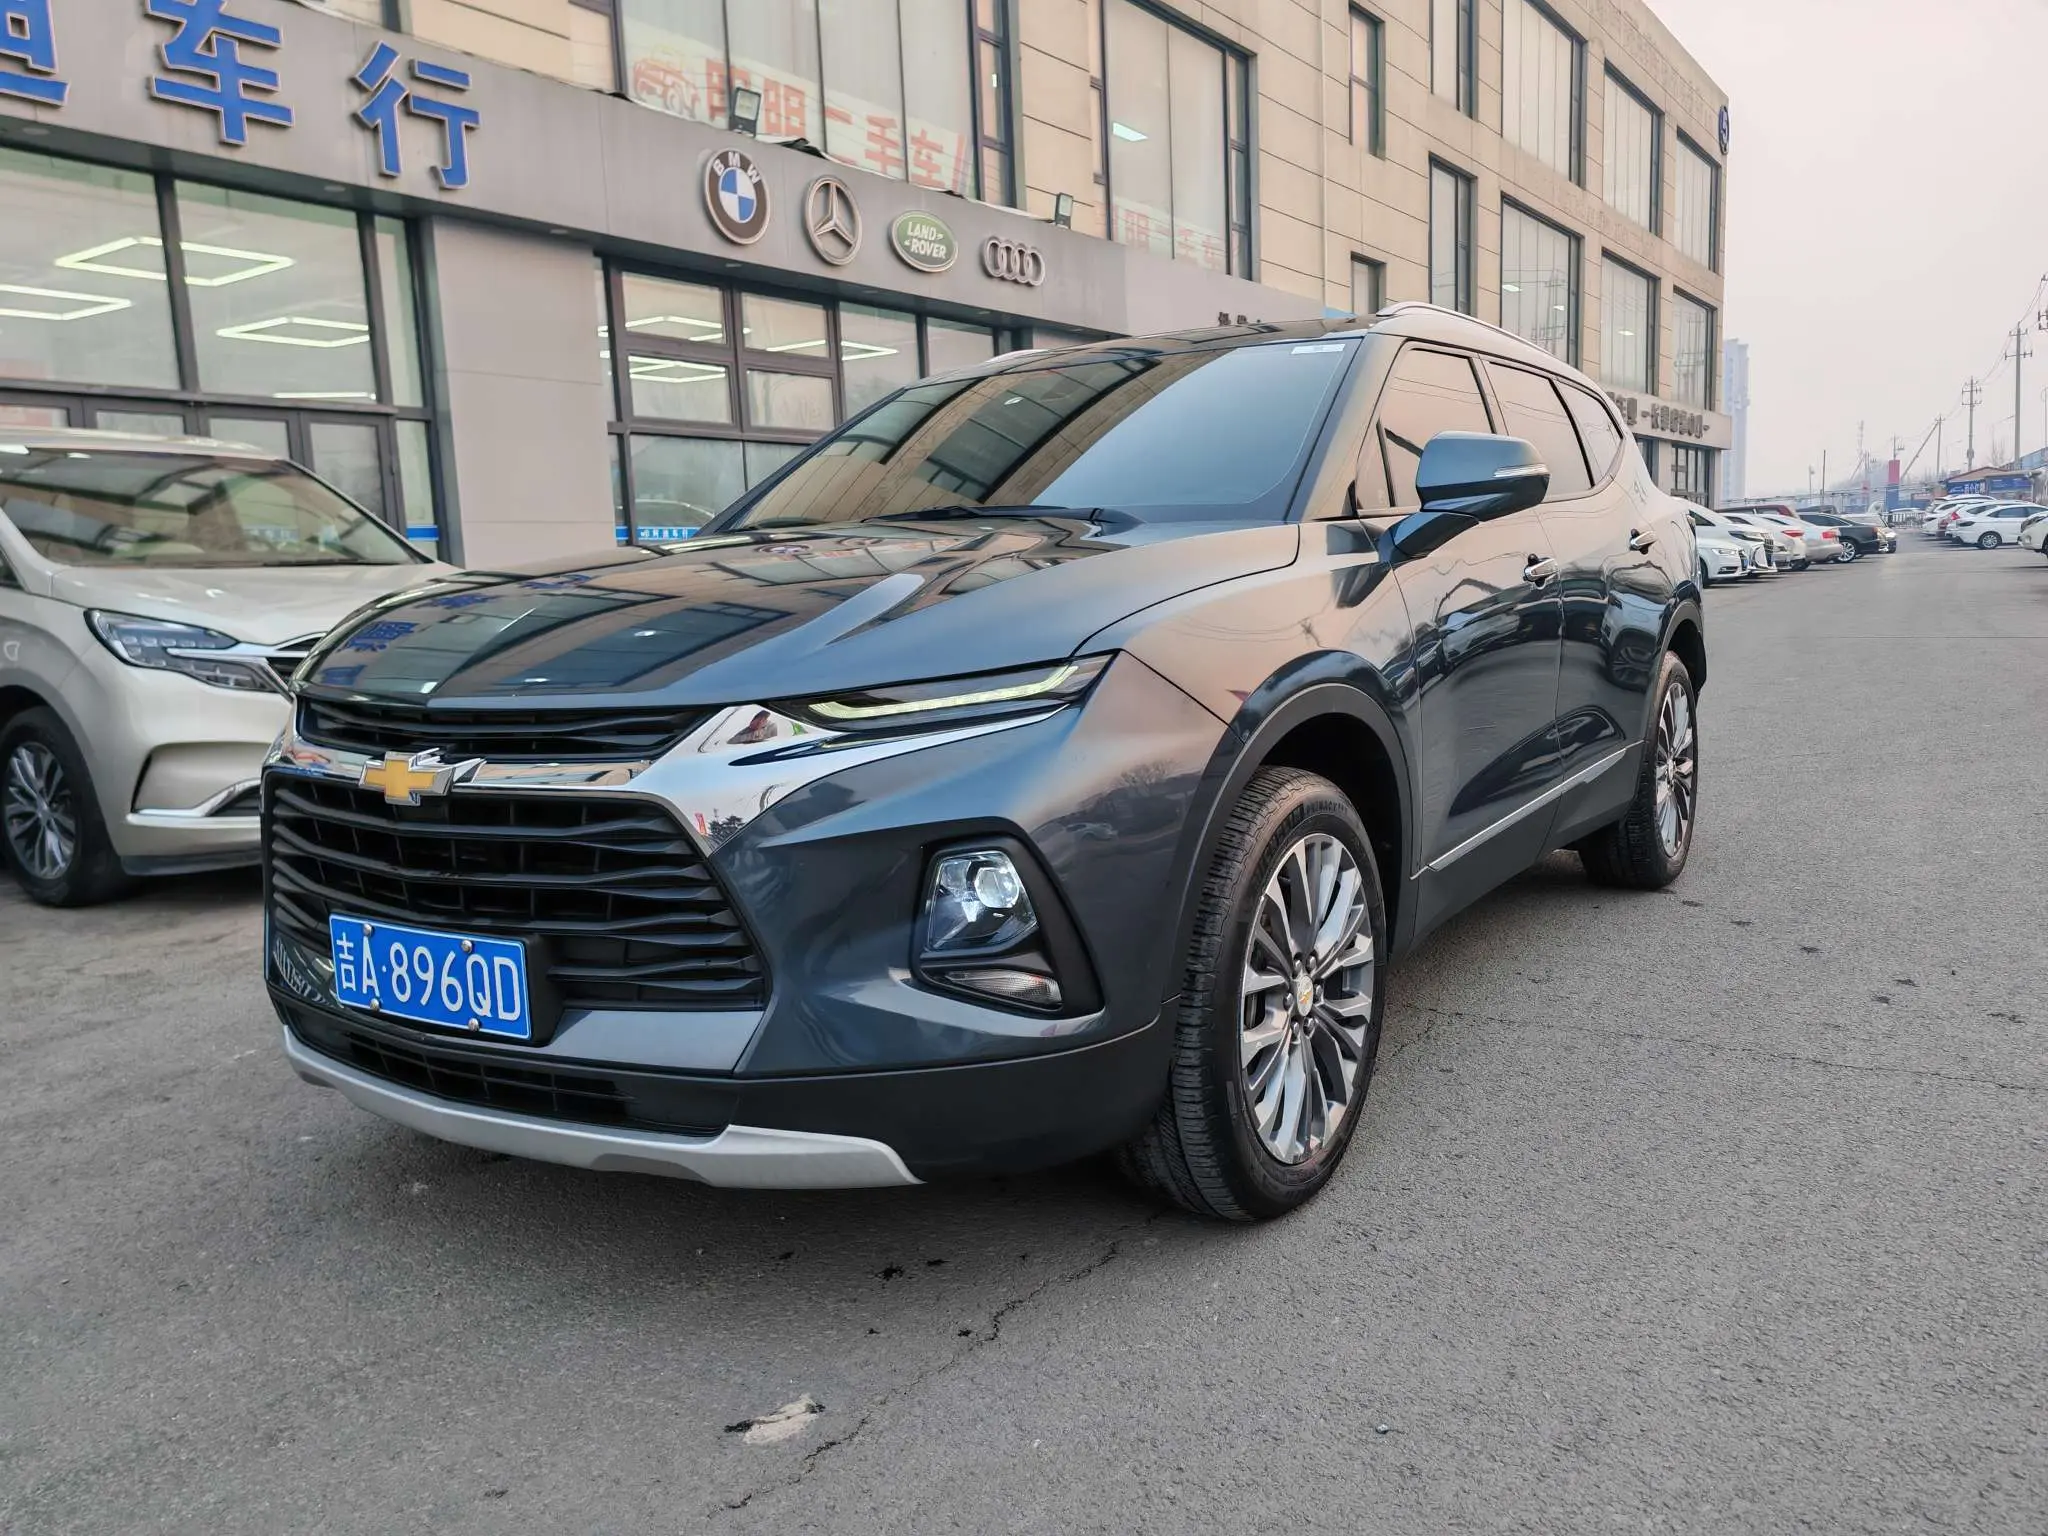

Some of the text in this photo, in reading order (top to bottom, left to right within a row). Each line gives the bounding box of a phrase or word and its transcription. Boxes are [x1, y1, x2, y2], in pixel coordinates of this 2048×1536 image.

[712, 151, 762, 185] BMW
[906, 221, 937, 241] LAND
[910, 239, 947, 259] ROVER
